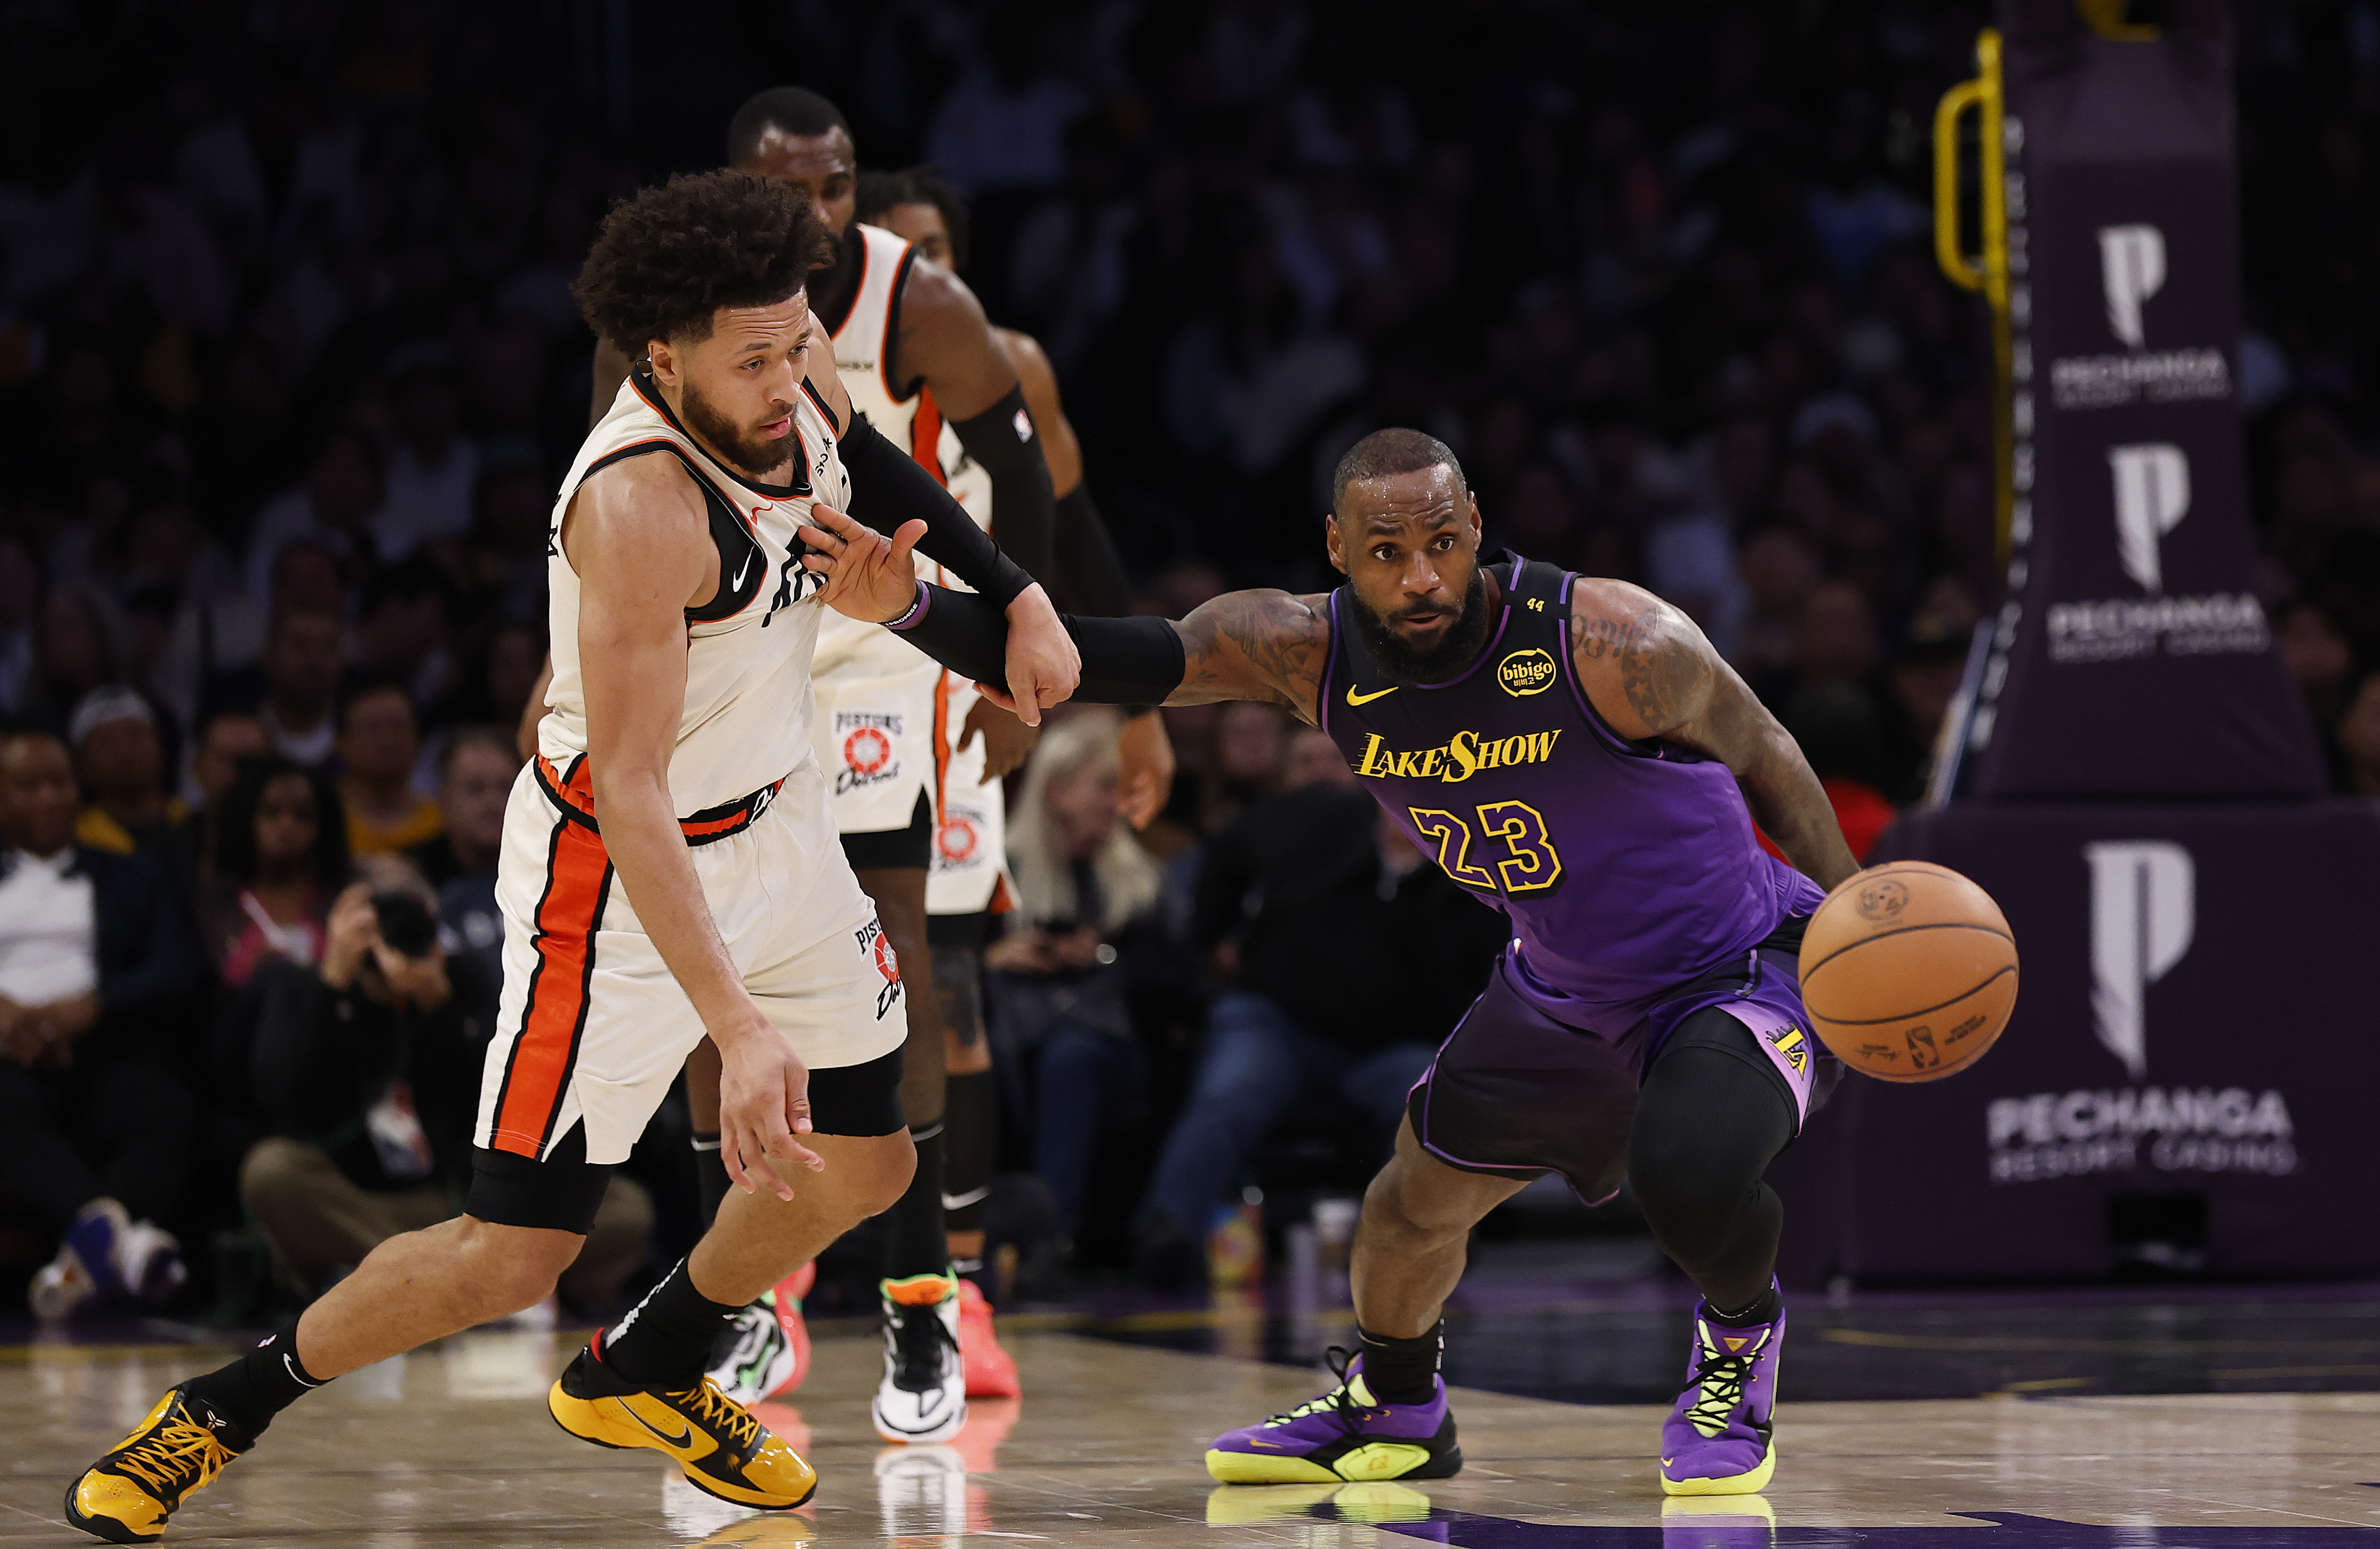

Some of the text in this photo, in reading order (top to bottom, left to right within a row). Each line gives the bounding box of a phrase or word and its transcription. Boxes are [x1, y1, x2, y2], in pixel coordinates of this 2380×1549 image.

[888, 603, 918, 626] PROMISE
[1527, 597, 1545, 612] 44
[1503, 661, 1553, 681] bibigo
[1513, 676, 1535, 687] 비비고
[1408, 799, 1565, 897] 23
[1987, 1085, 2294, 1147] PECHANGA
